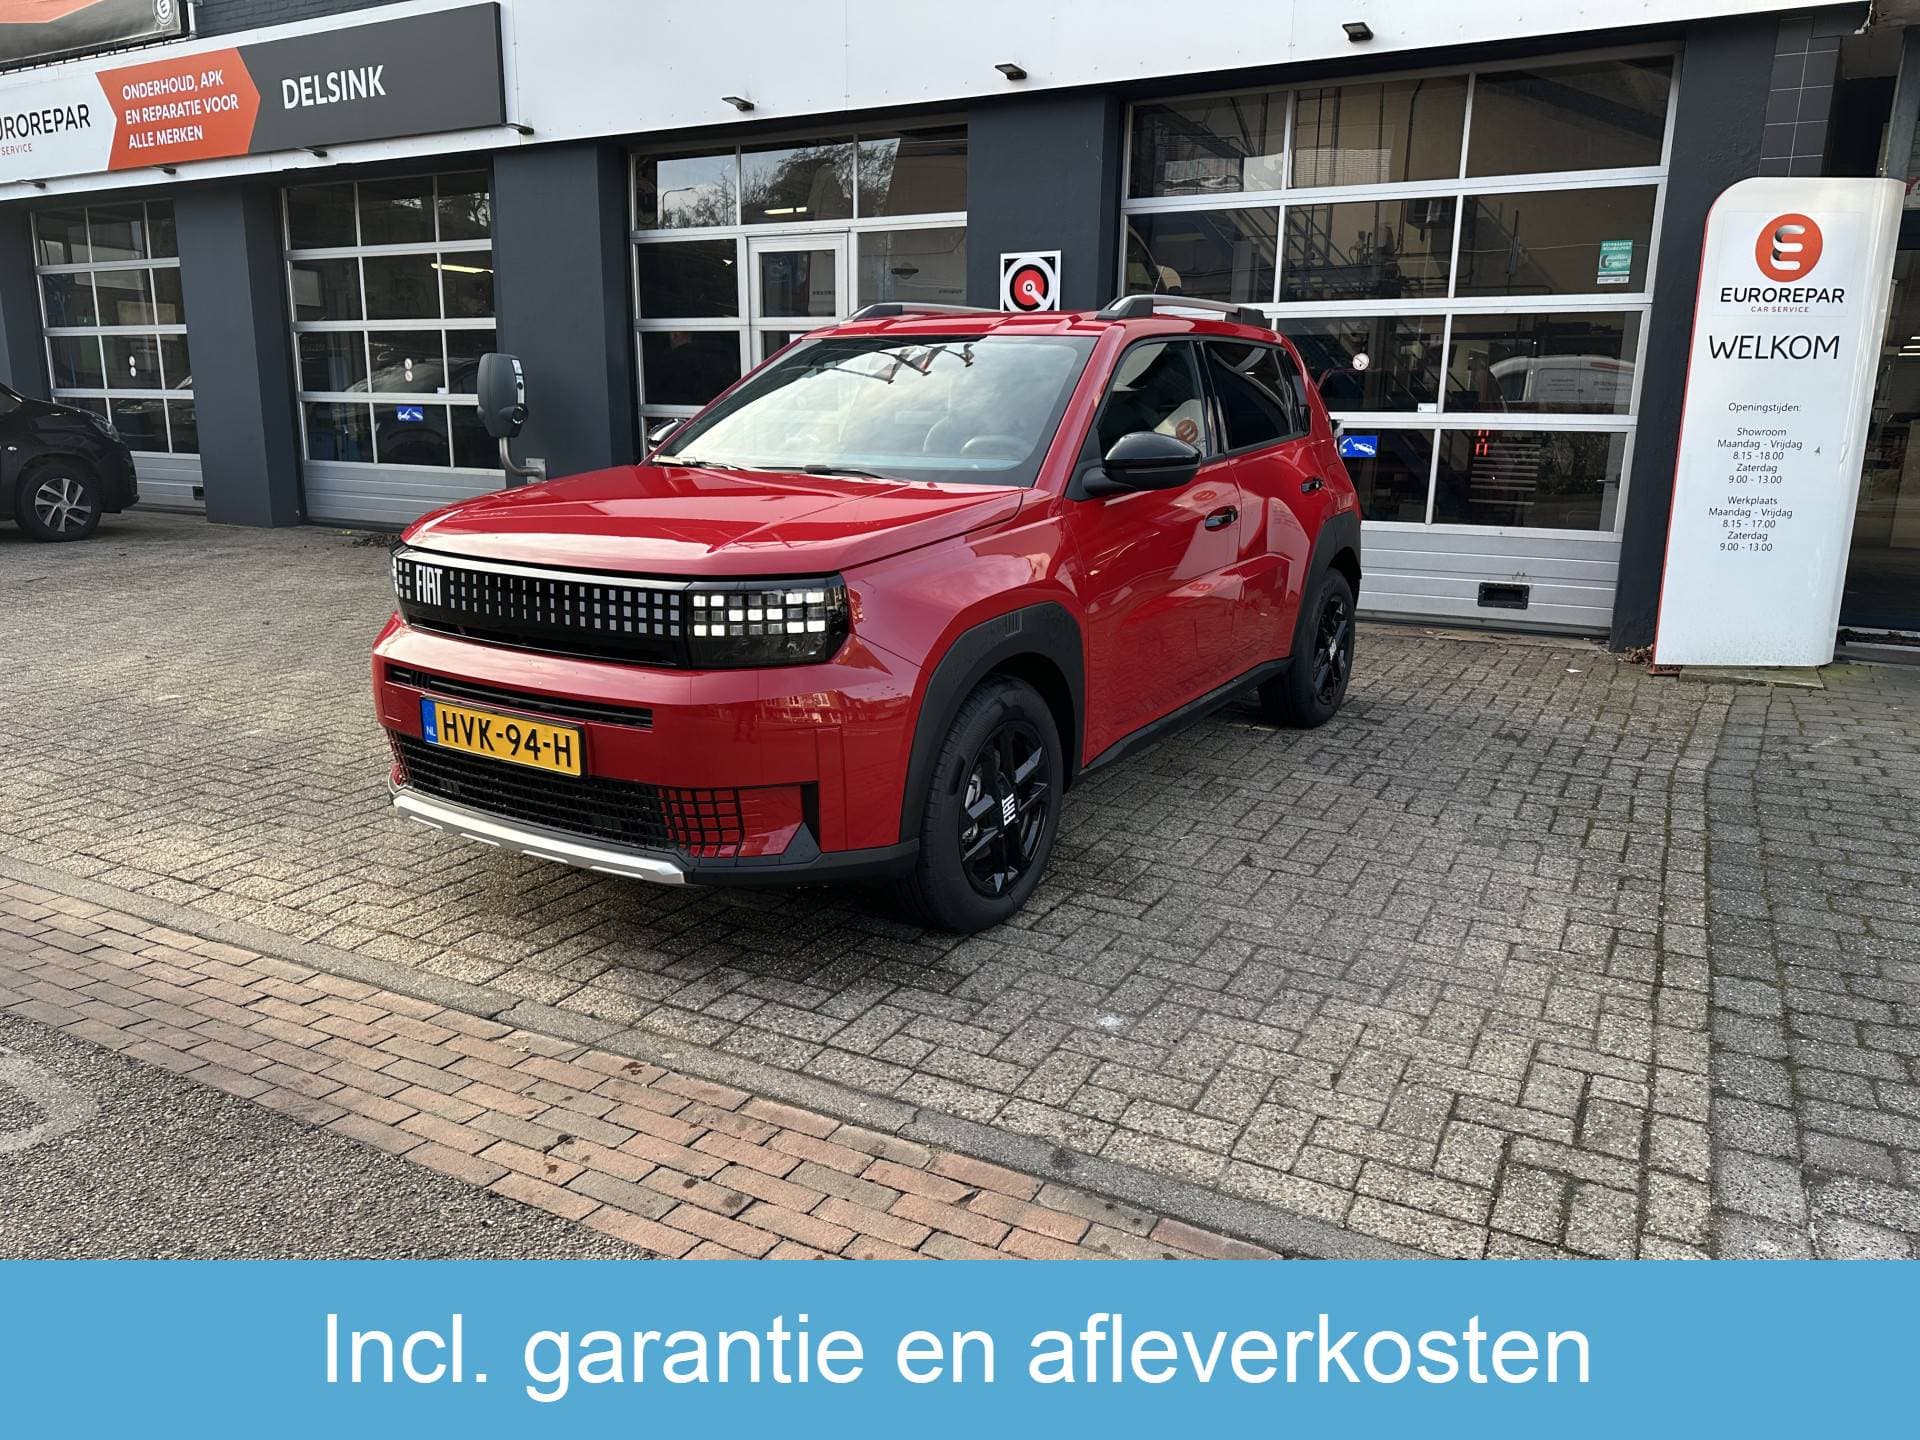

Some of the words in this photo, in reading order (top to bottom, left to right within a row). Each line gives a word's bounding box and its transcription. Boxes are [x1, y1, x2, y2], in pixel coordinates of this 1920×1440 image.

[122, 76, 198, 101] ONDERHOUD,
[200, 69, 224, 88] APK
[281, 64, 387, 110] DELSINK
[125, 109, 140, 125] EN
[143, 100, 201, 123] REPARATIE
[203, 93, 239, 113] VOOR
[0, 103, 92, 142] ROREPAR
[128, 131, 155, 150] ALLE
[156, 124, 204, 145] MERKEN
[1, 143, 33, 157] SERVICE
[1720, 287, 1846, 304] EUROREPAR
[1750, 305, 1769, 313] CAR
[1771, 306, 1810, 314] SERVICE
[1708, 335, 1841, 360] WELKOM
[1736, 427, 1788, 437] Showroom
[1717, 439, 1761, 451] Maandag
[1770, 439, 1804, 451] Vrijdag
[1732, 451, 1753, 461] 8.15
[1735, 462, 1779, 475] Zaterdag
[1728, 474, 1748, 485] 9.00
[1758, 474, 1783, 485] 13.00
[1727, 495, 1779, 507] Werkplaats
[1708, 507, 1752, 519] Maandag
[1761, 507, 1794, 520] Vrijdag
[1722, 519, 1743, 529] 8.15
[1751, 519, 1777, 529] 17.00
[1727, 530, 1769, 543] Zaterdag
[1719, 542, 1740, 552] 9.00
[1749, 542, 1774, 552] 13.00
[415, 564, 444, 606] FIAT
[426, 725, 437, 738] NL
[442, 710, 572, 768] HVK-94-H
[1002, 793, 1017, 826] FIAT
